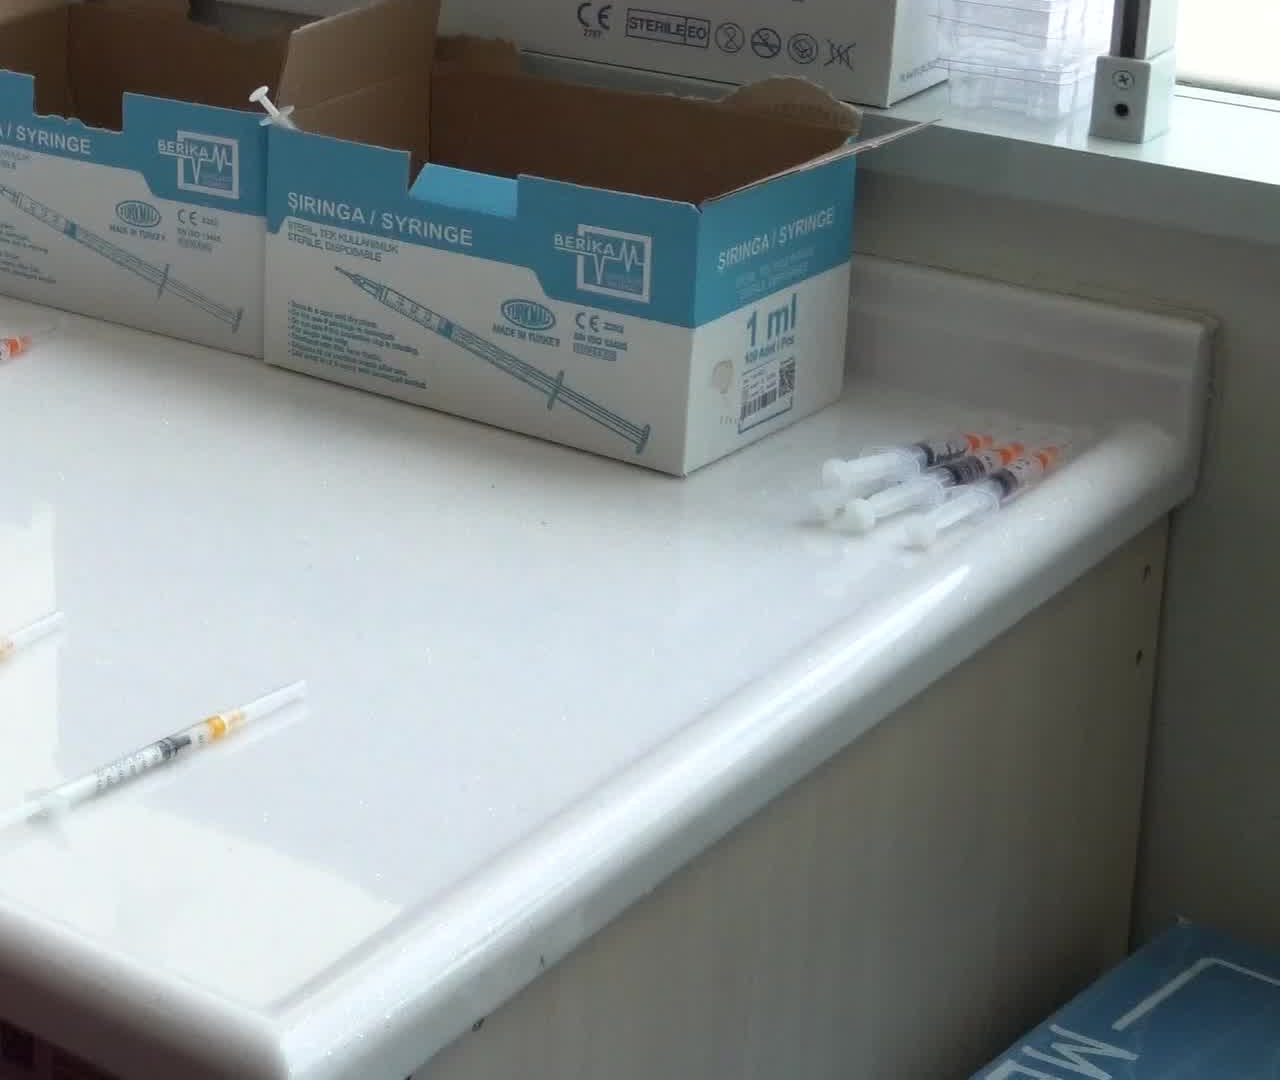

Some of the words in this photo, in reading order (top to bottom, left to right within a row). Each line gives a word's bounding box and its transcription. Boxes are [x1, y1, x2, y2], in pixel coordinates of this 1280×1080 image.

[629, 17, 686, 38] STERILE
[687, 25, 708, 41] EO
[15, 126, 92, 156] SYRINGE
[381, 212, 474, 247] SYRINGE
[778, 207, 834, 245] SYRINGE
[745, 311, 758, 347] 1
[767, 293, 797, 340] ml
